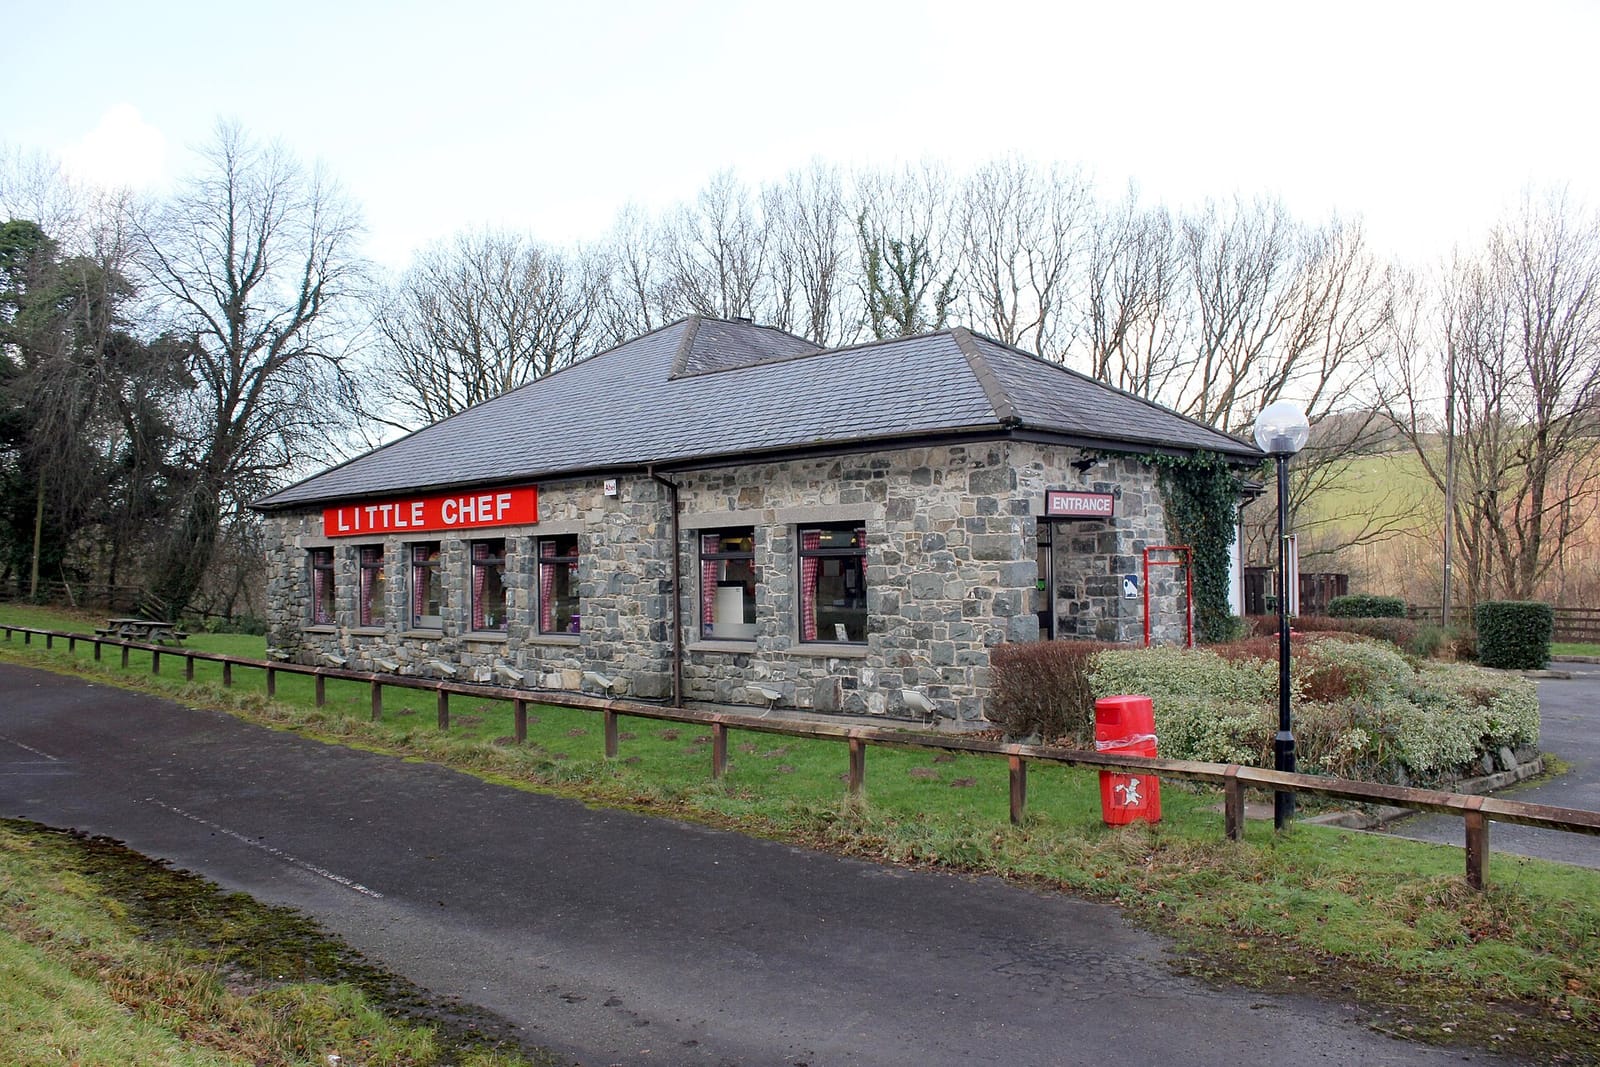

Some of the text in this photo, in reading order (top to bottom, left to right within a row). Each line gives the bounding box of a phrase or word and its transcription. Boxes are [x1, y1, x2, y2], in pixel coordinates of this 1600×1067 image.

[337, 493, 512, 531] LITTLE CHEF
[1053, 496, 1111, 511] ENTRANCE
